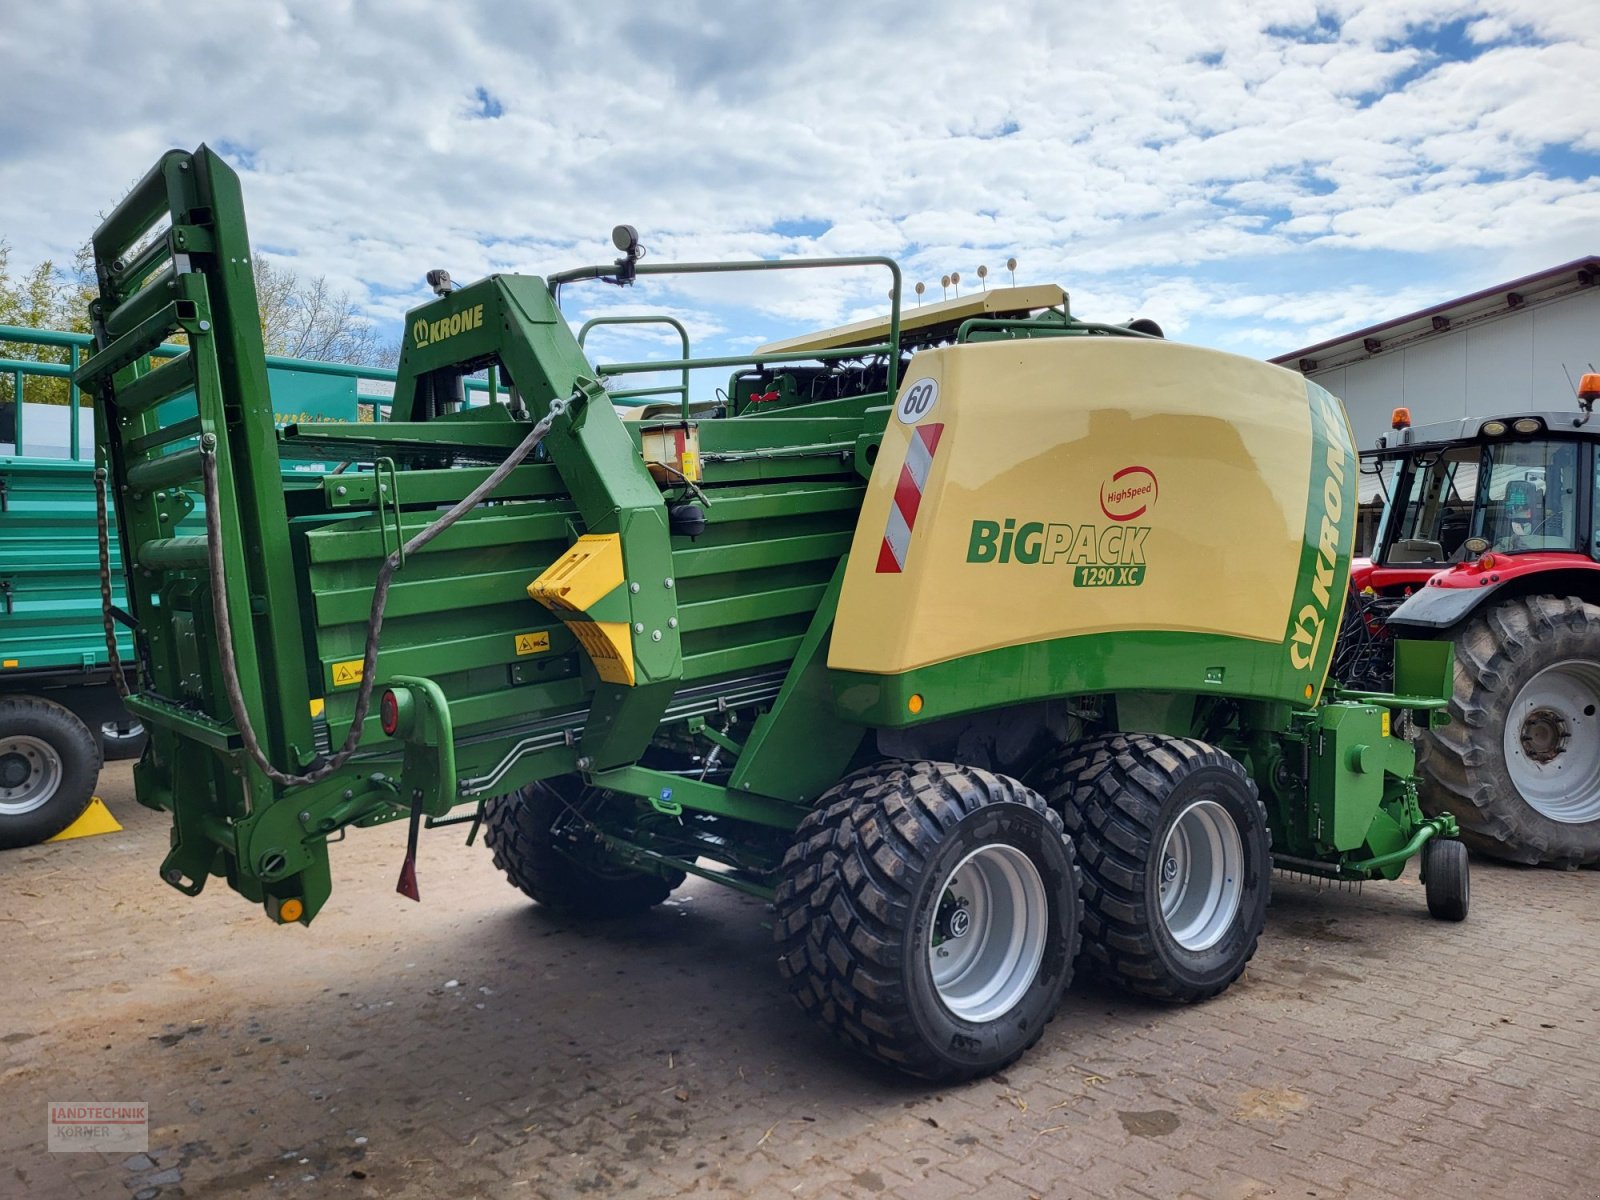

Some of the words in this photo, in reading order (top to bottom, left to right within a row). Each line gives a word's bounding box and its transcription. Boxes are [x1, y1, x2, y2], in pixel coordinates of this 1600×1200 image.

[430, 304, 483, 344] KRONE
[904, 384, 933, 415] 60
[1107, 483, 1152, 504] HighSpeed
[1312, 399, 1345, 610] KRONE
[1081, 568, 1114, 586] 1290
[1117, 567, 1138, 585] XC
